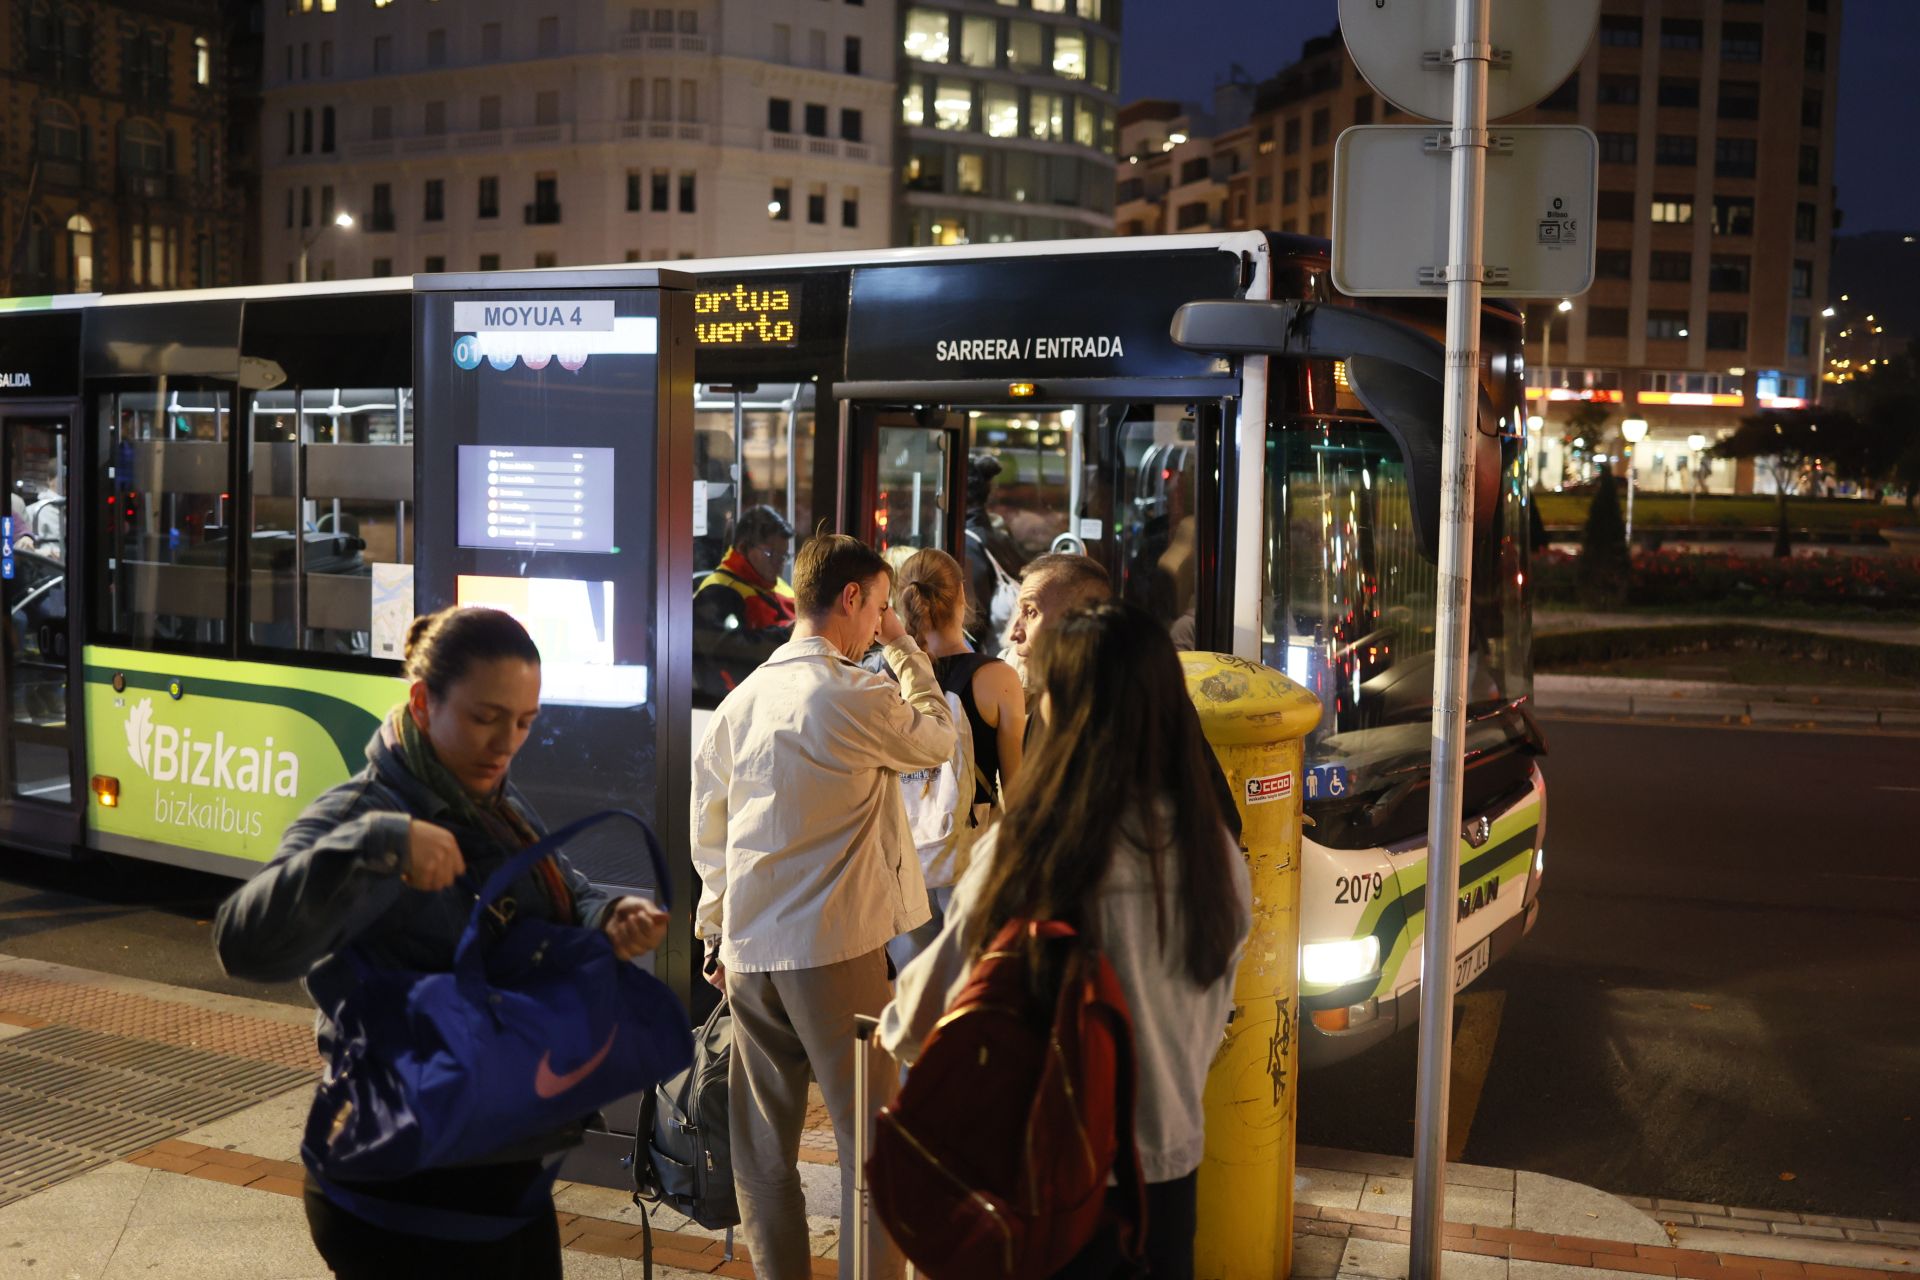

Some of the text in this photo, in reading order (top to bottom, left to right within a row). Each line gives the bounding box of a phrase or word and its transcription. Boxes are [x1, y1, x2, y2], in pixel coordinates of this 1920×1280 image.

[484, 306, 582, 326] MOYUA 4
[695, 314, 794, 343] uerto
[936, 338, 1020, 361] SARRERA
[1035, 335, 1124, 359] ENTRADA
[153, 724, 299, 798] Bizkaia
[1263, 778, 1289, 792] CCOO
[155, 788, 263, 837] bizkaibus
[1335, 872, 1383, 904] 2079
[1457, 876, 1500, 924] MAN
